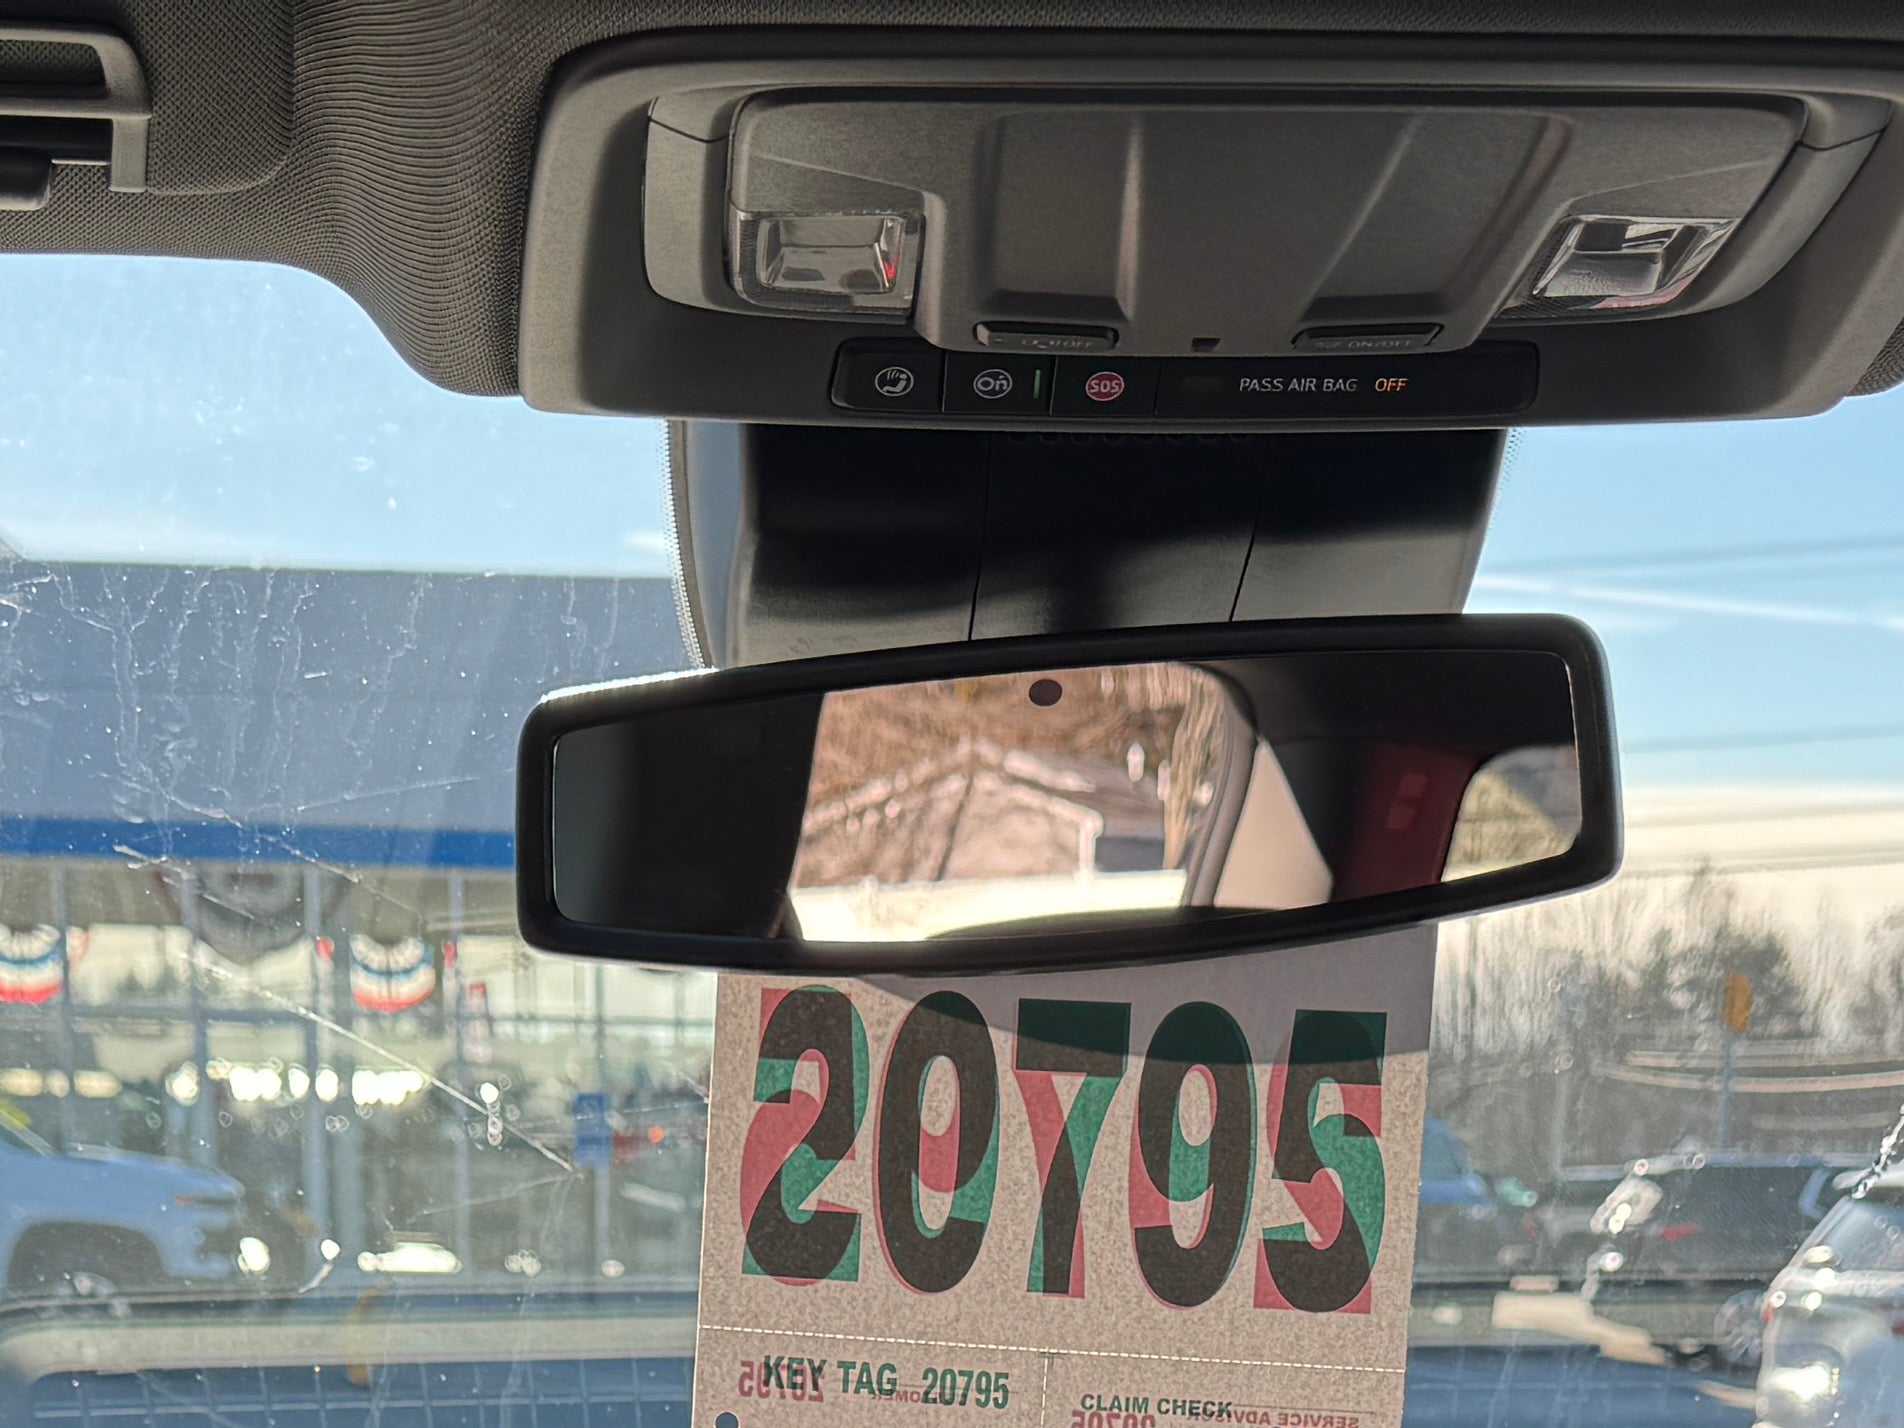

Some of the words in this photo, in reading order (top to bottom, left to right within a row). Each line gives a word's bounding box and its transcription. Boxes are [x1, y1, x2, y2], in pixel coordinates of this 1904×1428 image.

[1089, 379, 1122, 394] SOS
[1239, 377, 1283, 392] PASS
[1287, 377, 1317, 392] AIR
[1322, 377, 1359, 392] BAG
[1374, 377, 1409, 392] OFF
[741, 984, 1387, 1314] 20795
[763, 1355, 827, 1392] KEY
[837, 1361, 897, 1396] TAG
[921, 1367, 1010, 1409] 20795
[1080, 1394, 1149, 1413] CLAIM
[1157, 1398, 1233, 1418] CHECK
